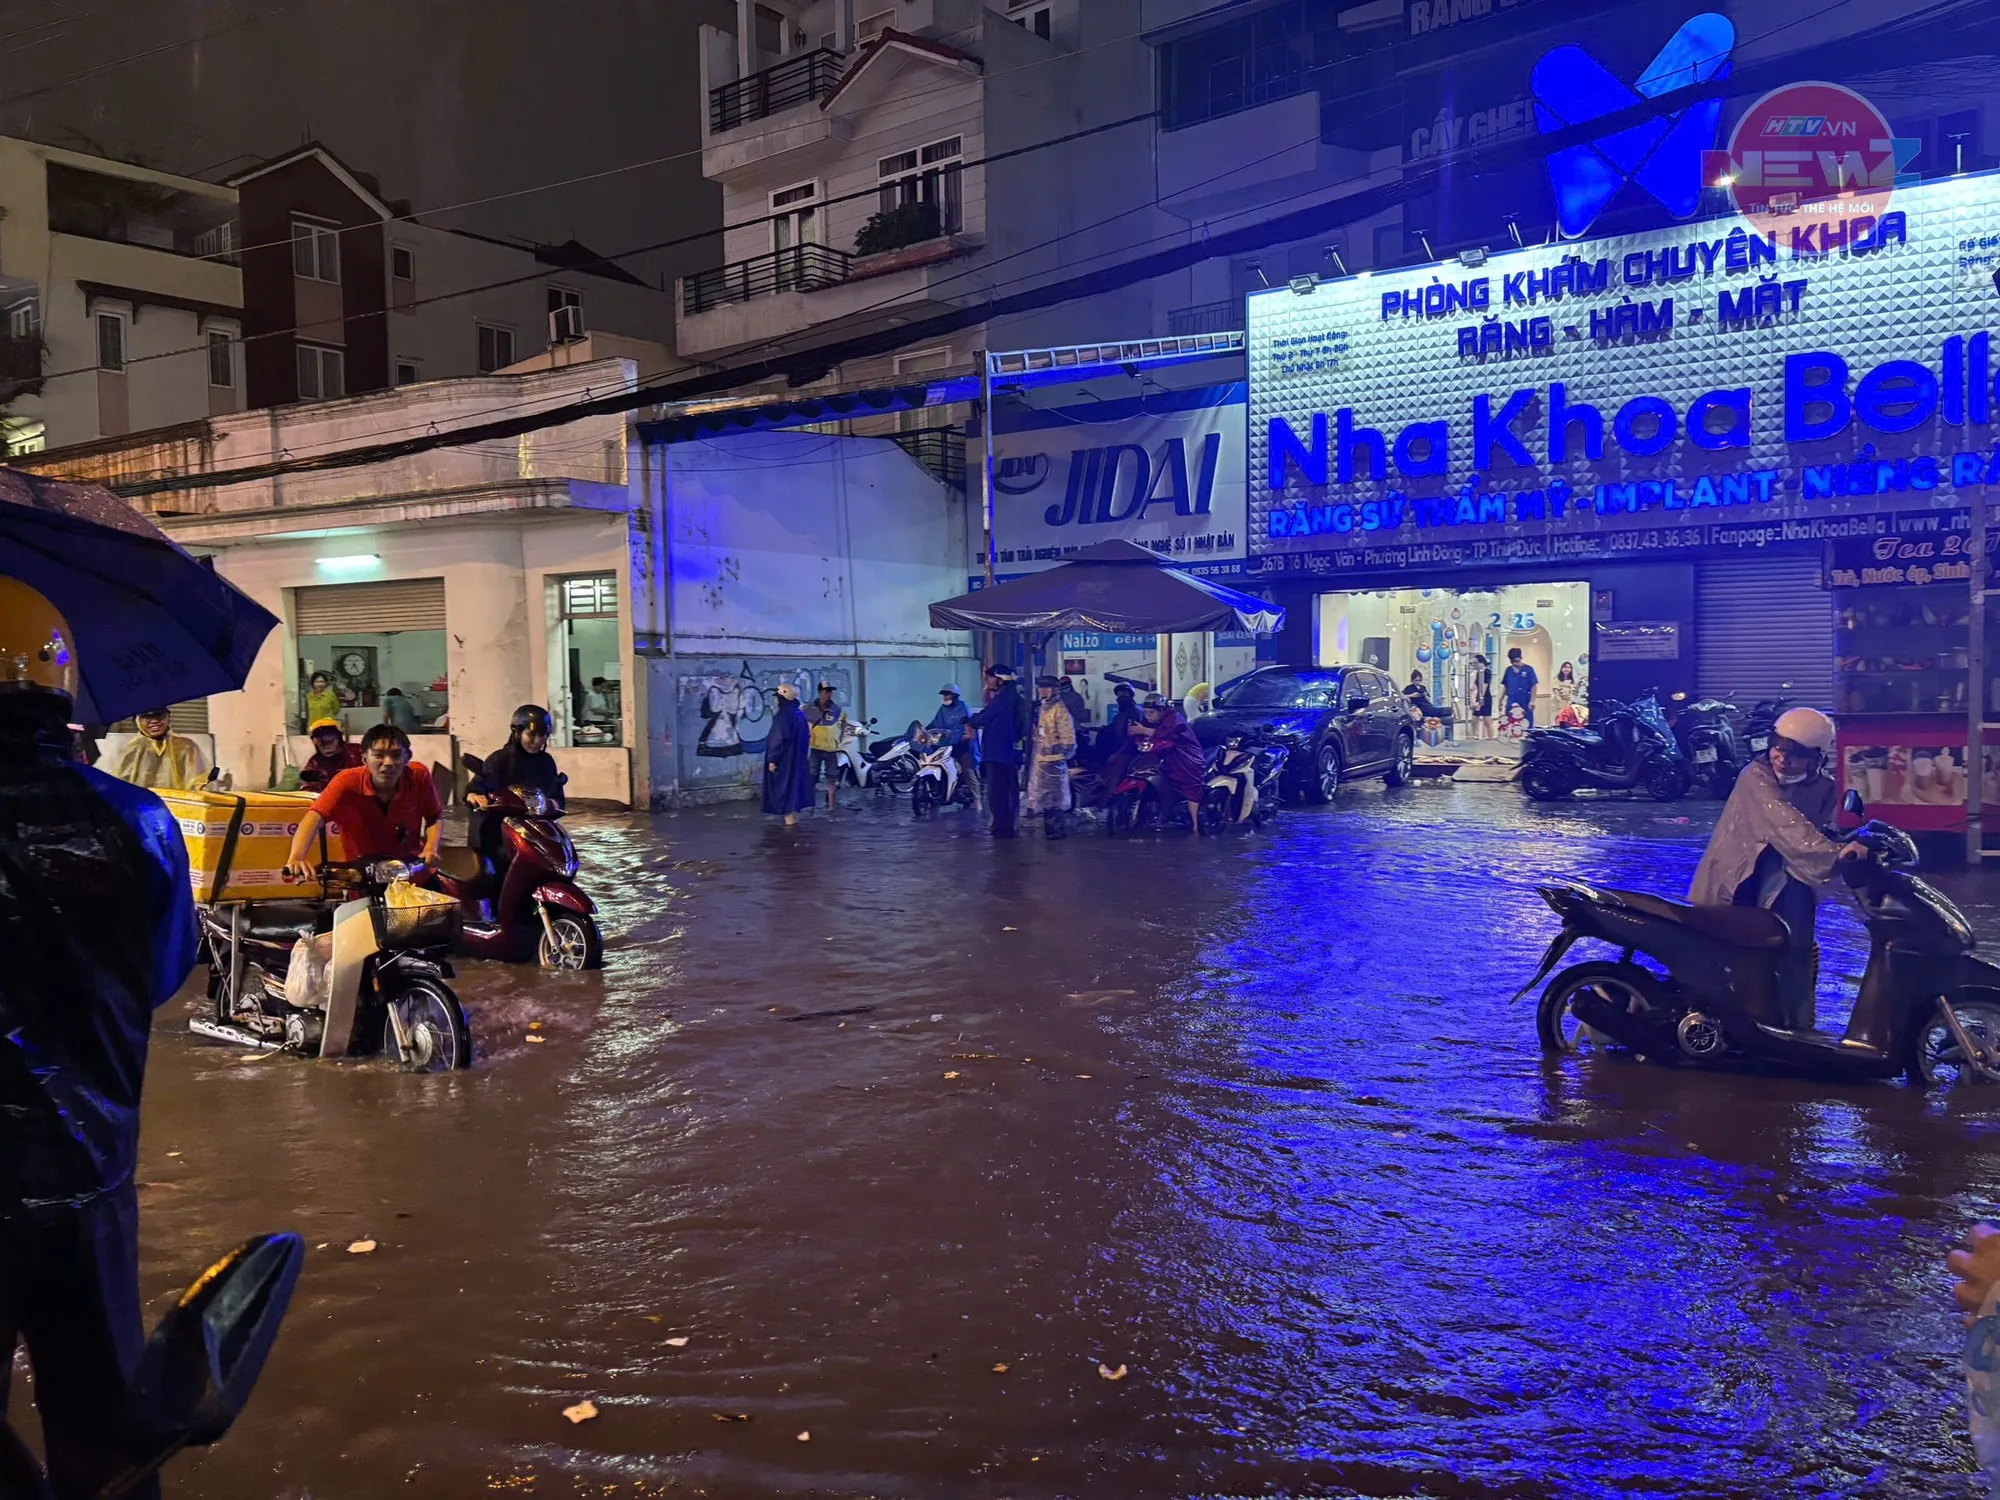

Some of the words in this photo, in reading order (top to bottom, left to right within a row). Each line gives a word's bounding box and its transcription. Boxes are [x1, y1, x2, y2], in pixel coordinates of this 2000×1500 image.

[1382, 276, 1490, 321] PHÒNG
[1503, 254, 1608, 303] KHÁM
[1623, 227, 1777, 284] CHUYÊN
[1792, 211, 1907, 259] KHOA
[1457, 314, 1552, 356] RĂNG
[1590, 296, 1674, 340] HÀM
[1719, 273, 1809, 323] MẶT
[1269, 407, 1448, 490] Nha
[1473, 383, 1753, 470] Khoa
[1785, 331, 2000, 442] Bell
[999, 455, 1037, 478] JIDAI
[1044, 433, 1221, 527] JIDAI
[1268, 502, 1353, 538] RĂNG
[1360, 489, 1407, 531] SỨ
[1410, 475, 1506, 529] THẨM
[1515, 479, 1572, 522] MỸ
[1595, 469, 1778, 516] IMPLANT
[1802, 442, 1939, 500] NIỀNG
[1175, 532, 1186, 550] SỐ
[1217, 530, 1235, 547] BẢN
[1261, 555, 1285, 571] 267B
[1304, 552, 1331, 574] Ngọc
[1408, 547, 1431, 563] Linh
[1873, 536, 1935, 561] Tea
[1862, 566, 1905, 585] Nước
